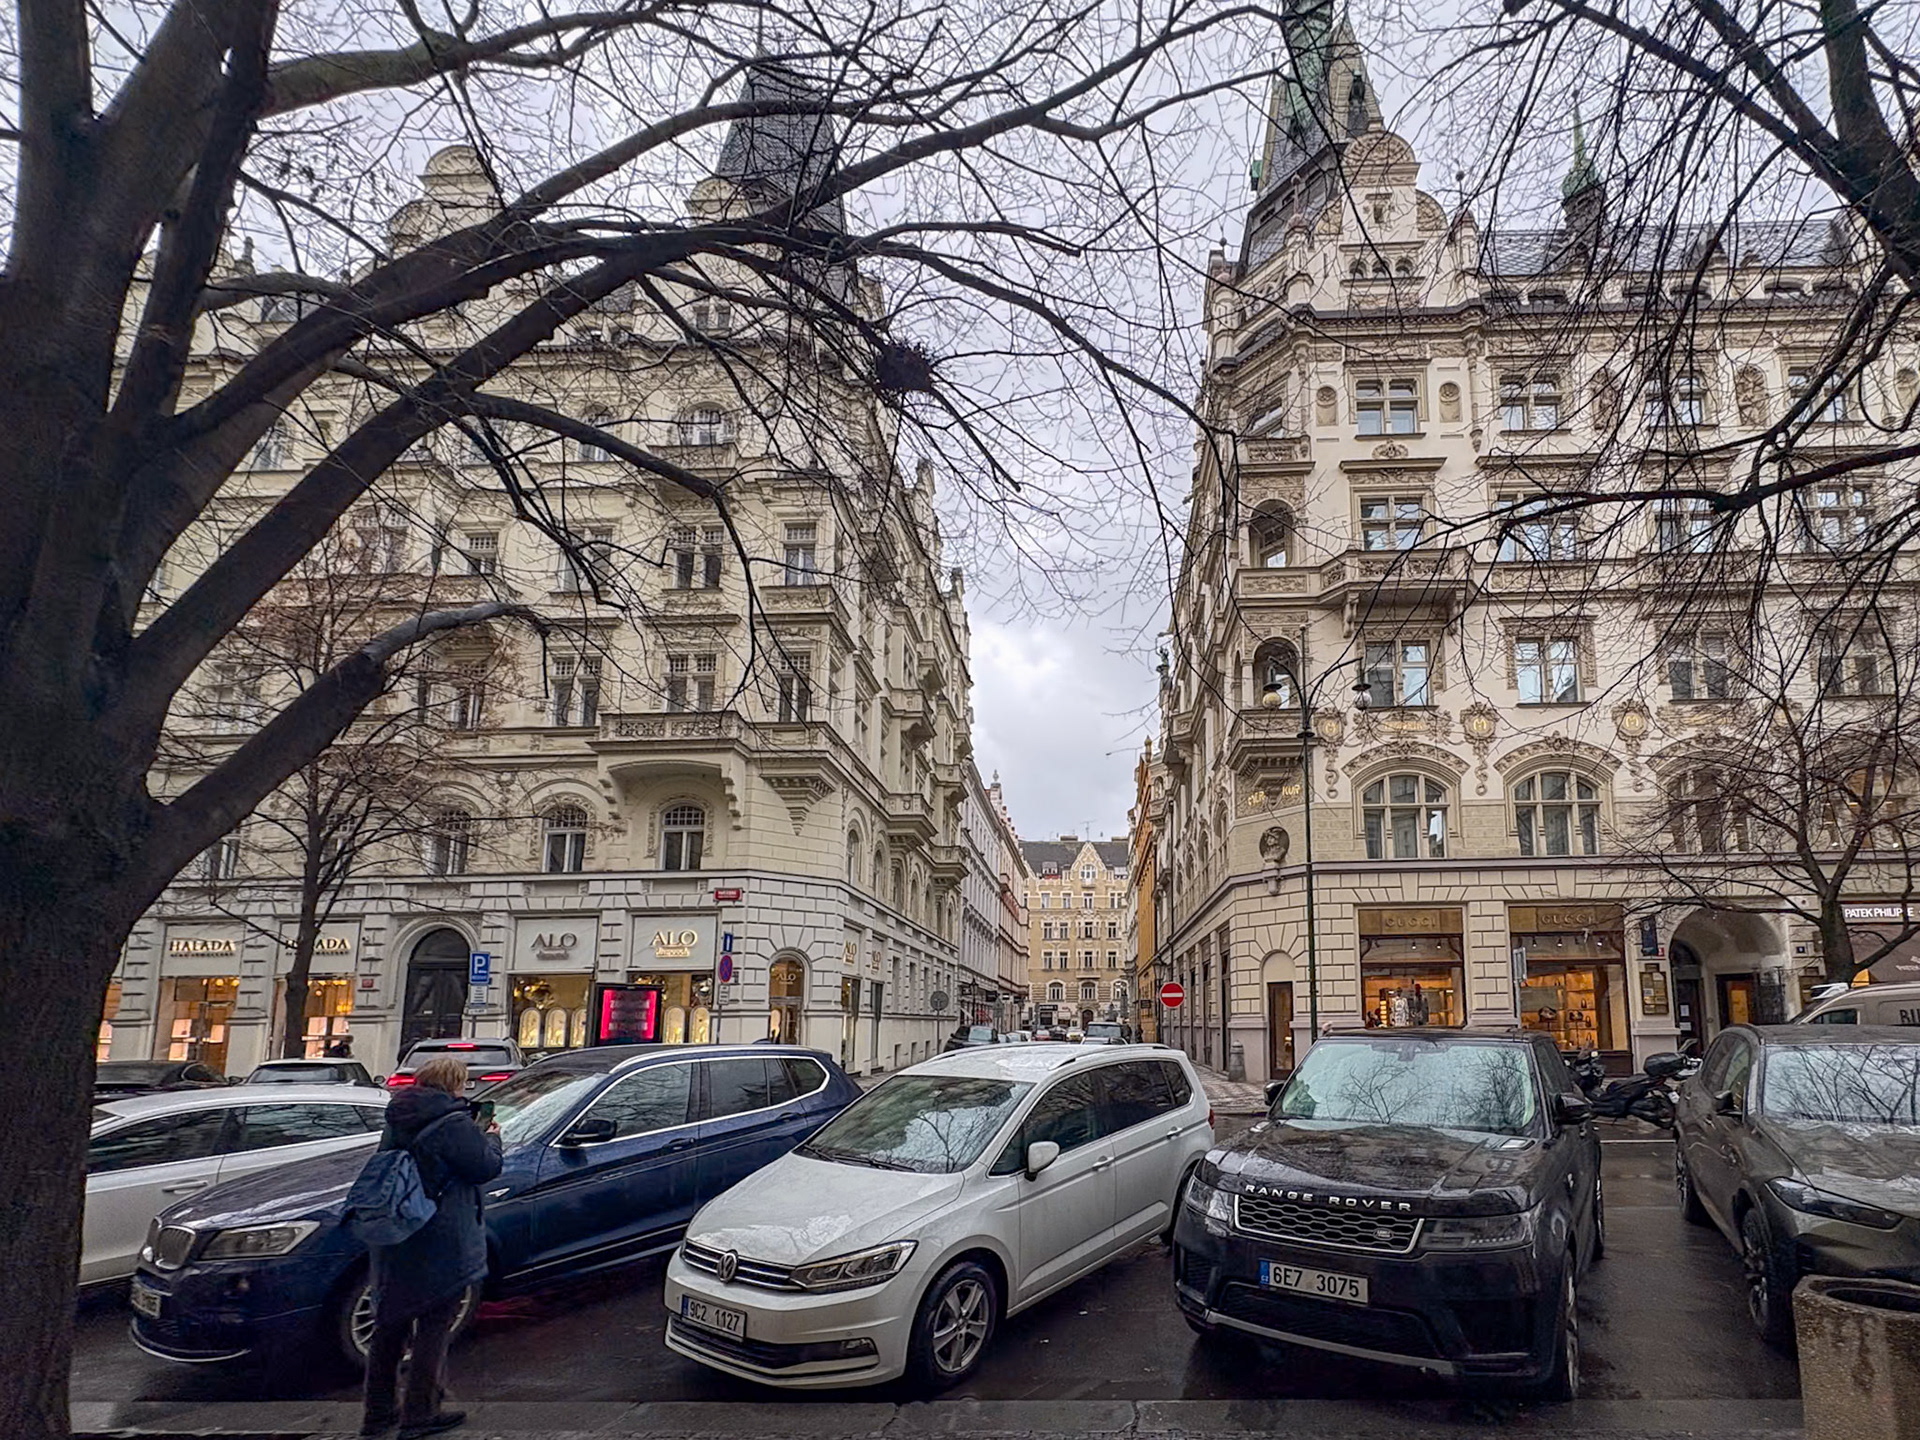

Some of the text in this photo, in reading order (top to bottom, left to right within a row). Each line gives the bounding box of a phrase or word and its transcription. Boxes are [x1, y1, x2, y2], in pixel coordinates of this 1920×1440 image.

[1282, 784, 1301, 796] KUR
[1541, 914, 1592, 925] GUCCI
[1845, 907, 1914, 918] PATEK PHILIPE
[1386, 917, 1436, 928] GUCCI
[531, 932, 577, 948] ALO
[650, 930, 697, 946] ALO
[170, 940, 235, 951] HALADA
[474, 956, 486, 974] P
[776, 973, 796, 981] ALO
[1245, 1184, 1411, 1212] RANGE ROVER
[1273, 1266, 1359, 1298] 6E7 3075
[690, 1301, 740, 1331] 9C2 1127
